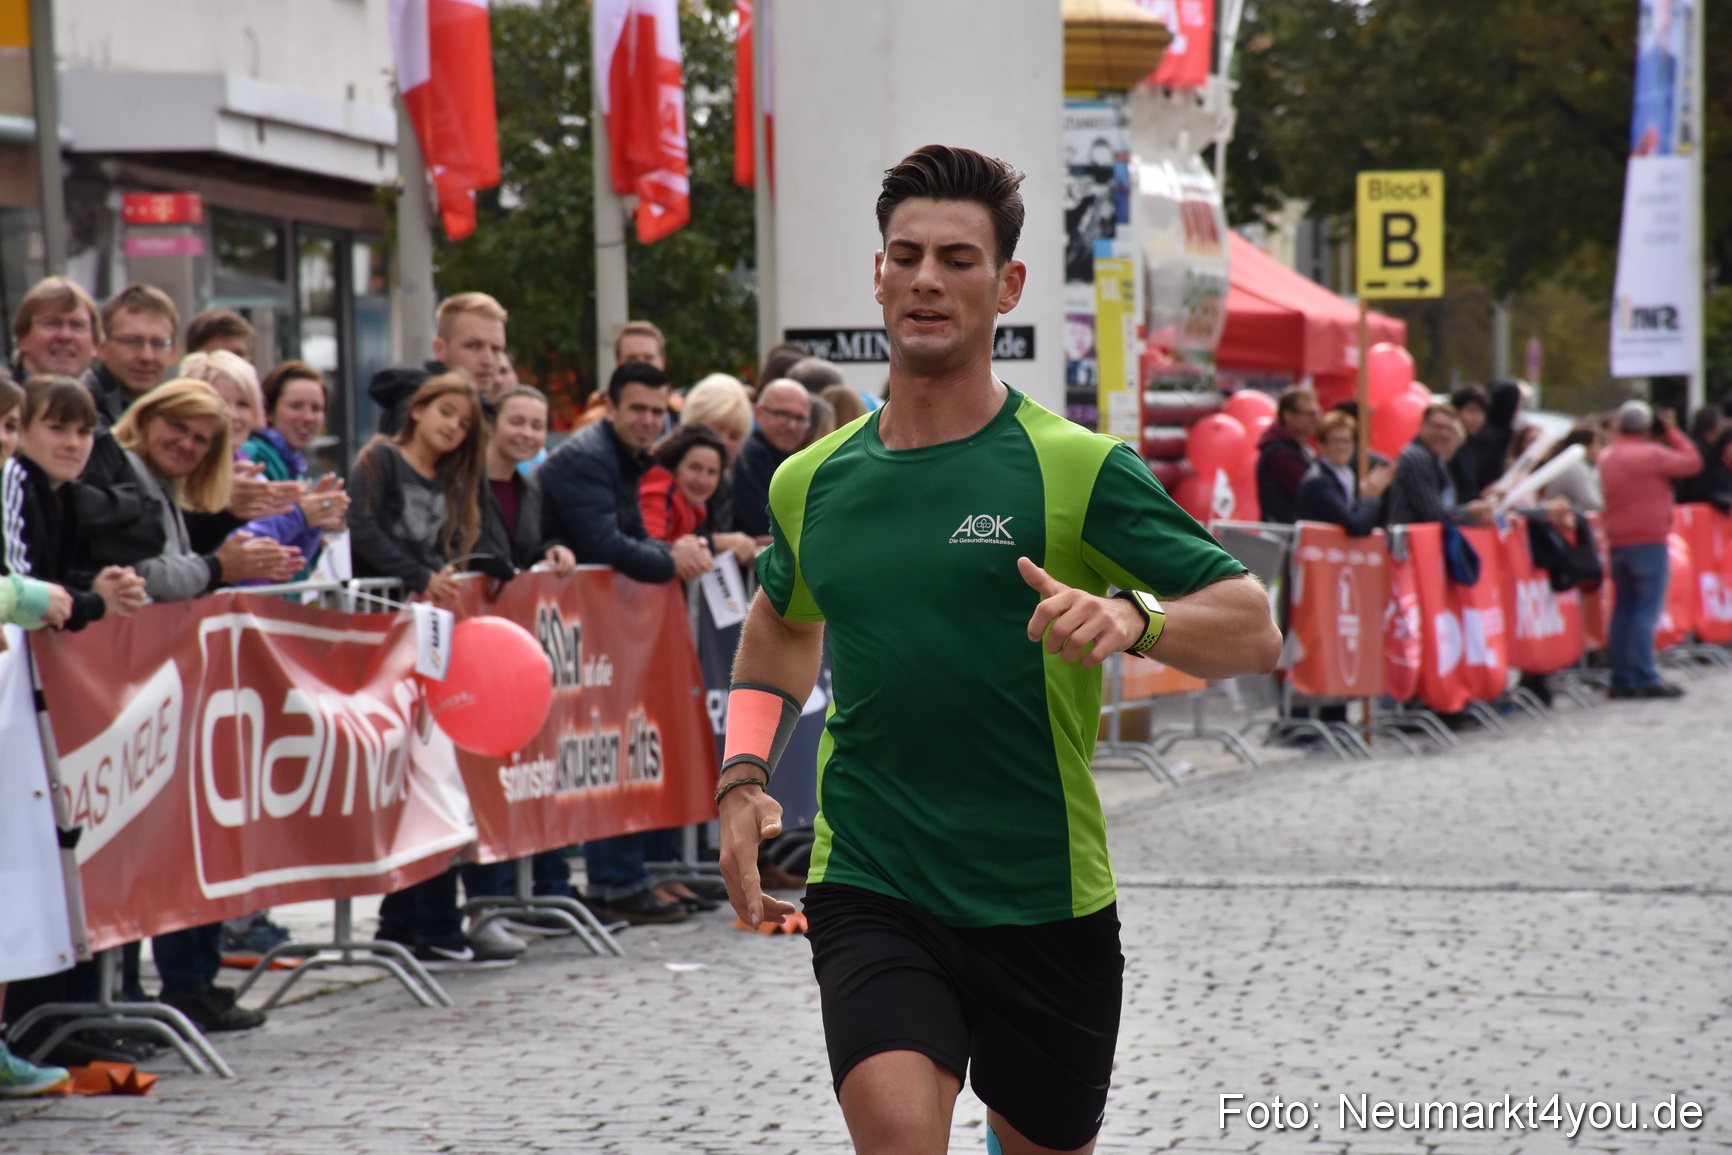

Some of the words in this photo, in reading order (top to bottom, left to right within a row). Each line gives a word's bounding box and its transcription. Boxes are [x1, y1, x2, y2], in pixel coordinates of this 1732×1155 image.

[1368, 179, 1430, 201] Block
[1382, 212, 1421, 268] B
[951, 514, 1014, 539] AOK
[959, 537, 1017, 546] Gesundheitskasse.
[119, 696, 172, 807] NEUE
